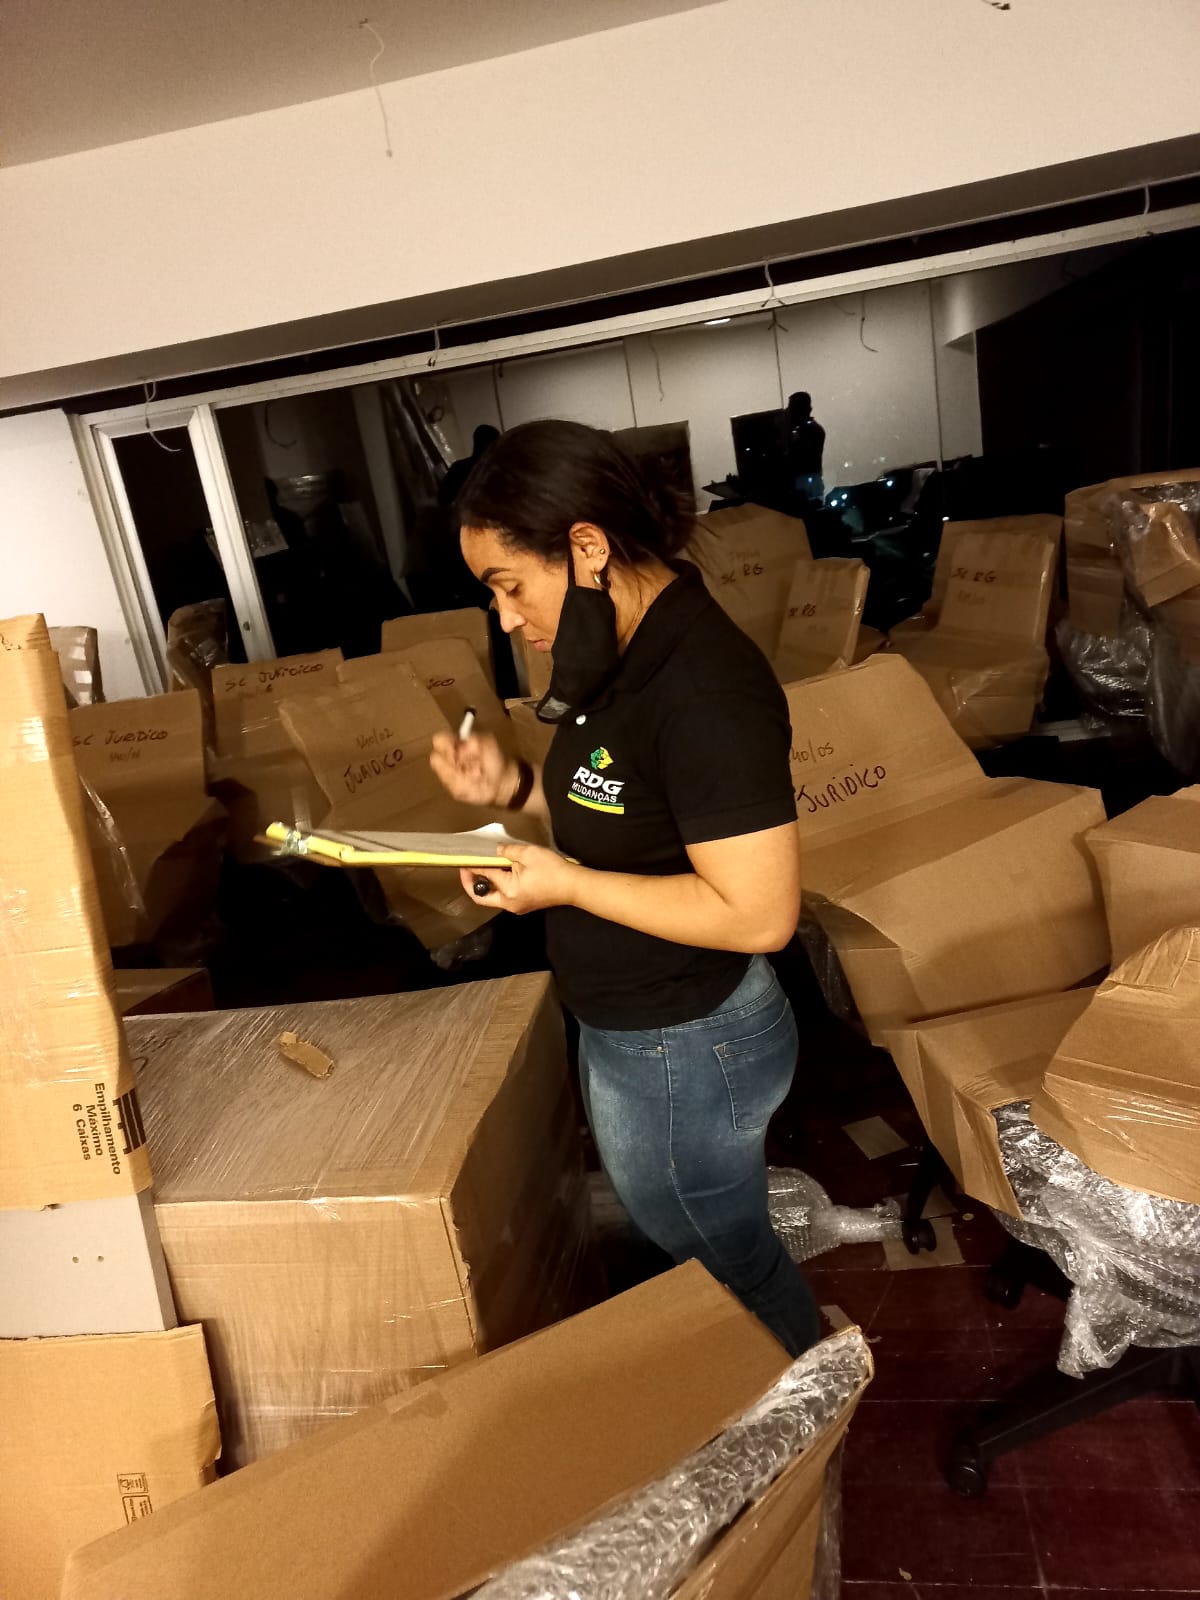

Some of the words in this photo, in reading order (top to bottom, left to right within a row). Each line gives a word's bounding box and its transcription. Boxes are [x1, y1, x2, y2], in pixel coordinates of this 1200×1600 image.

[573, 766, 625, 795] RDG
[72, 1103, 83, 1112] 6
[76, 1118, 91, 1161] Caixas
[94, 1082, 120, 1175] Empilhamento
